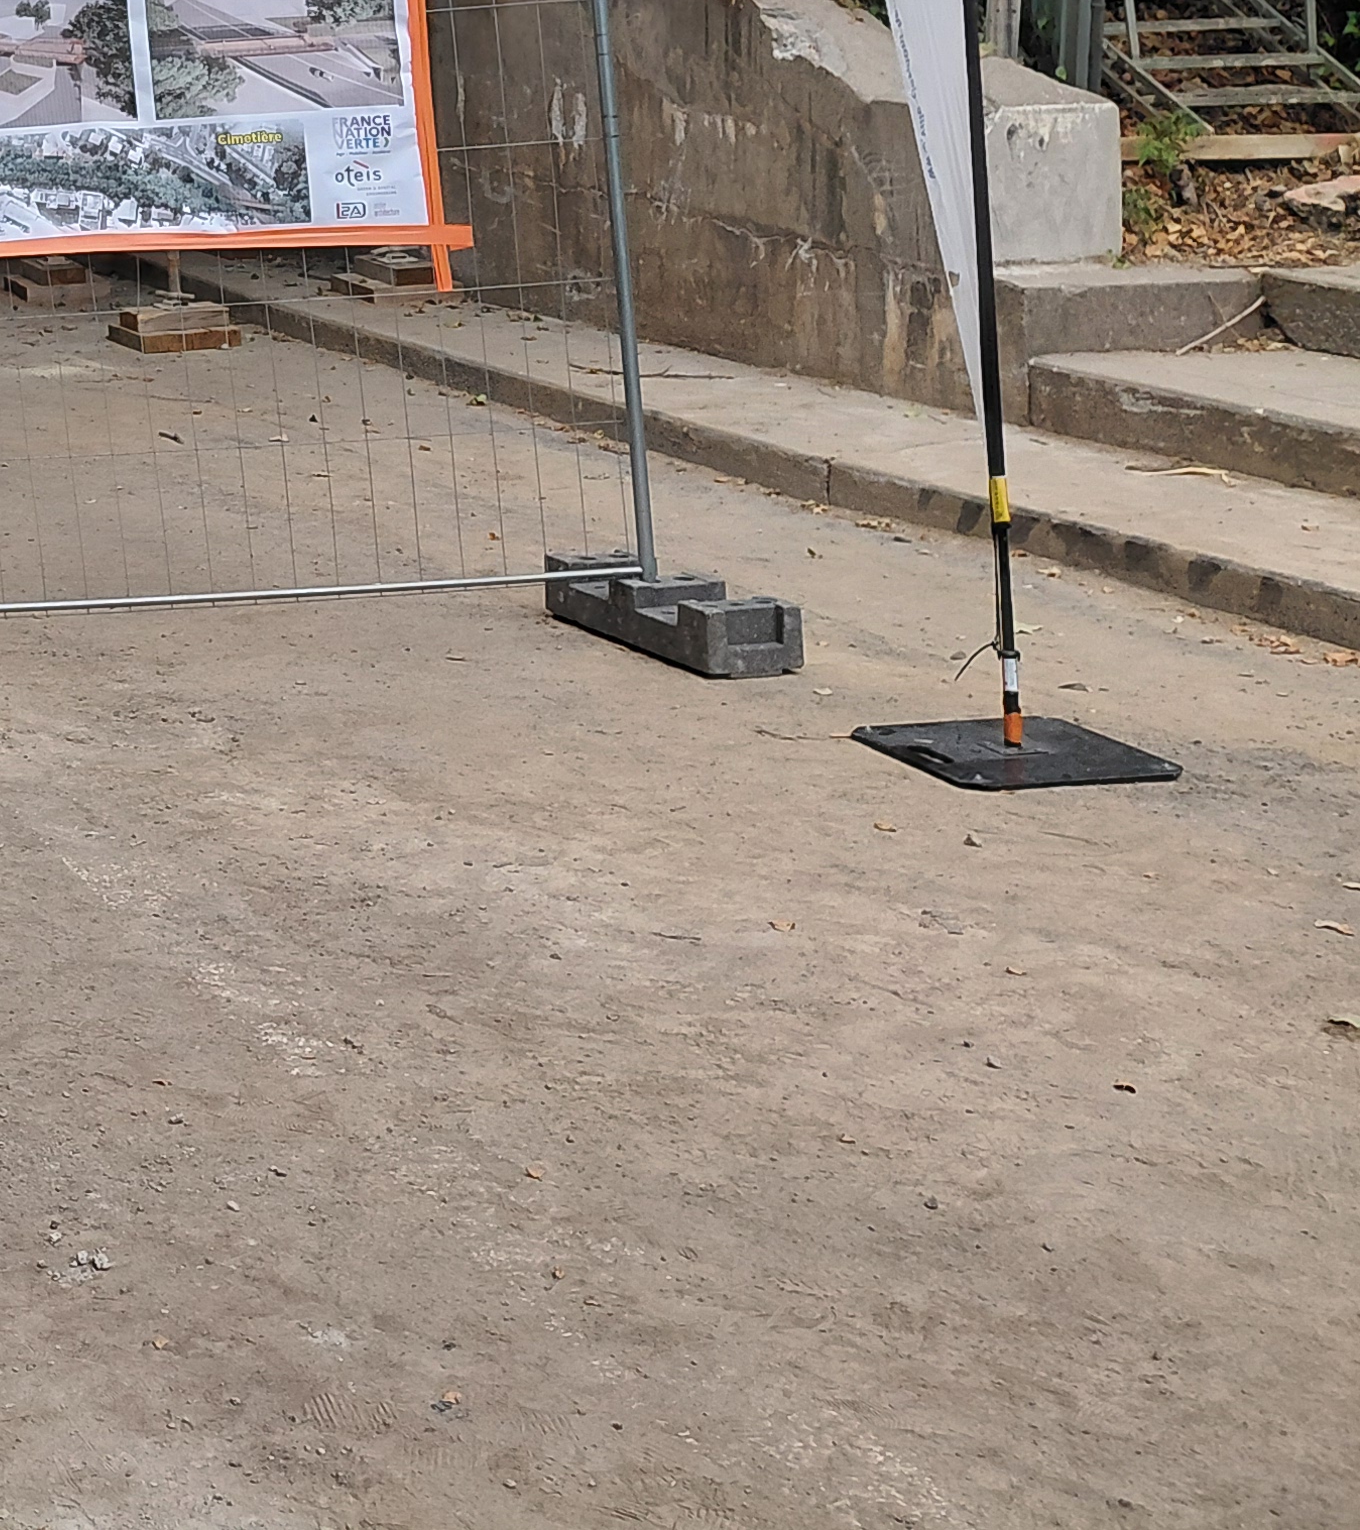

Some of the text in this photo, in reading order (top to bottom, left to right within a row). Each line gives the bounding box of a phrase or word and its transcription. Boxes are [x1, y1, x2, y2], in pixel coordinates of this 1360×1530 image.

[332, 114, 391, 128] FRANCE
[217, 129, 283, 146] Cimetière
[333, 126, 391, 139] NATION
[334, 137, 380, 150] VERTE
[334, 160, 382, 187] oteis
